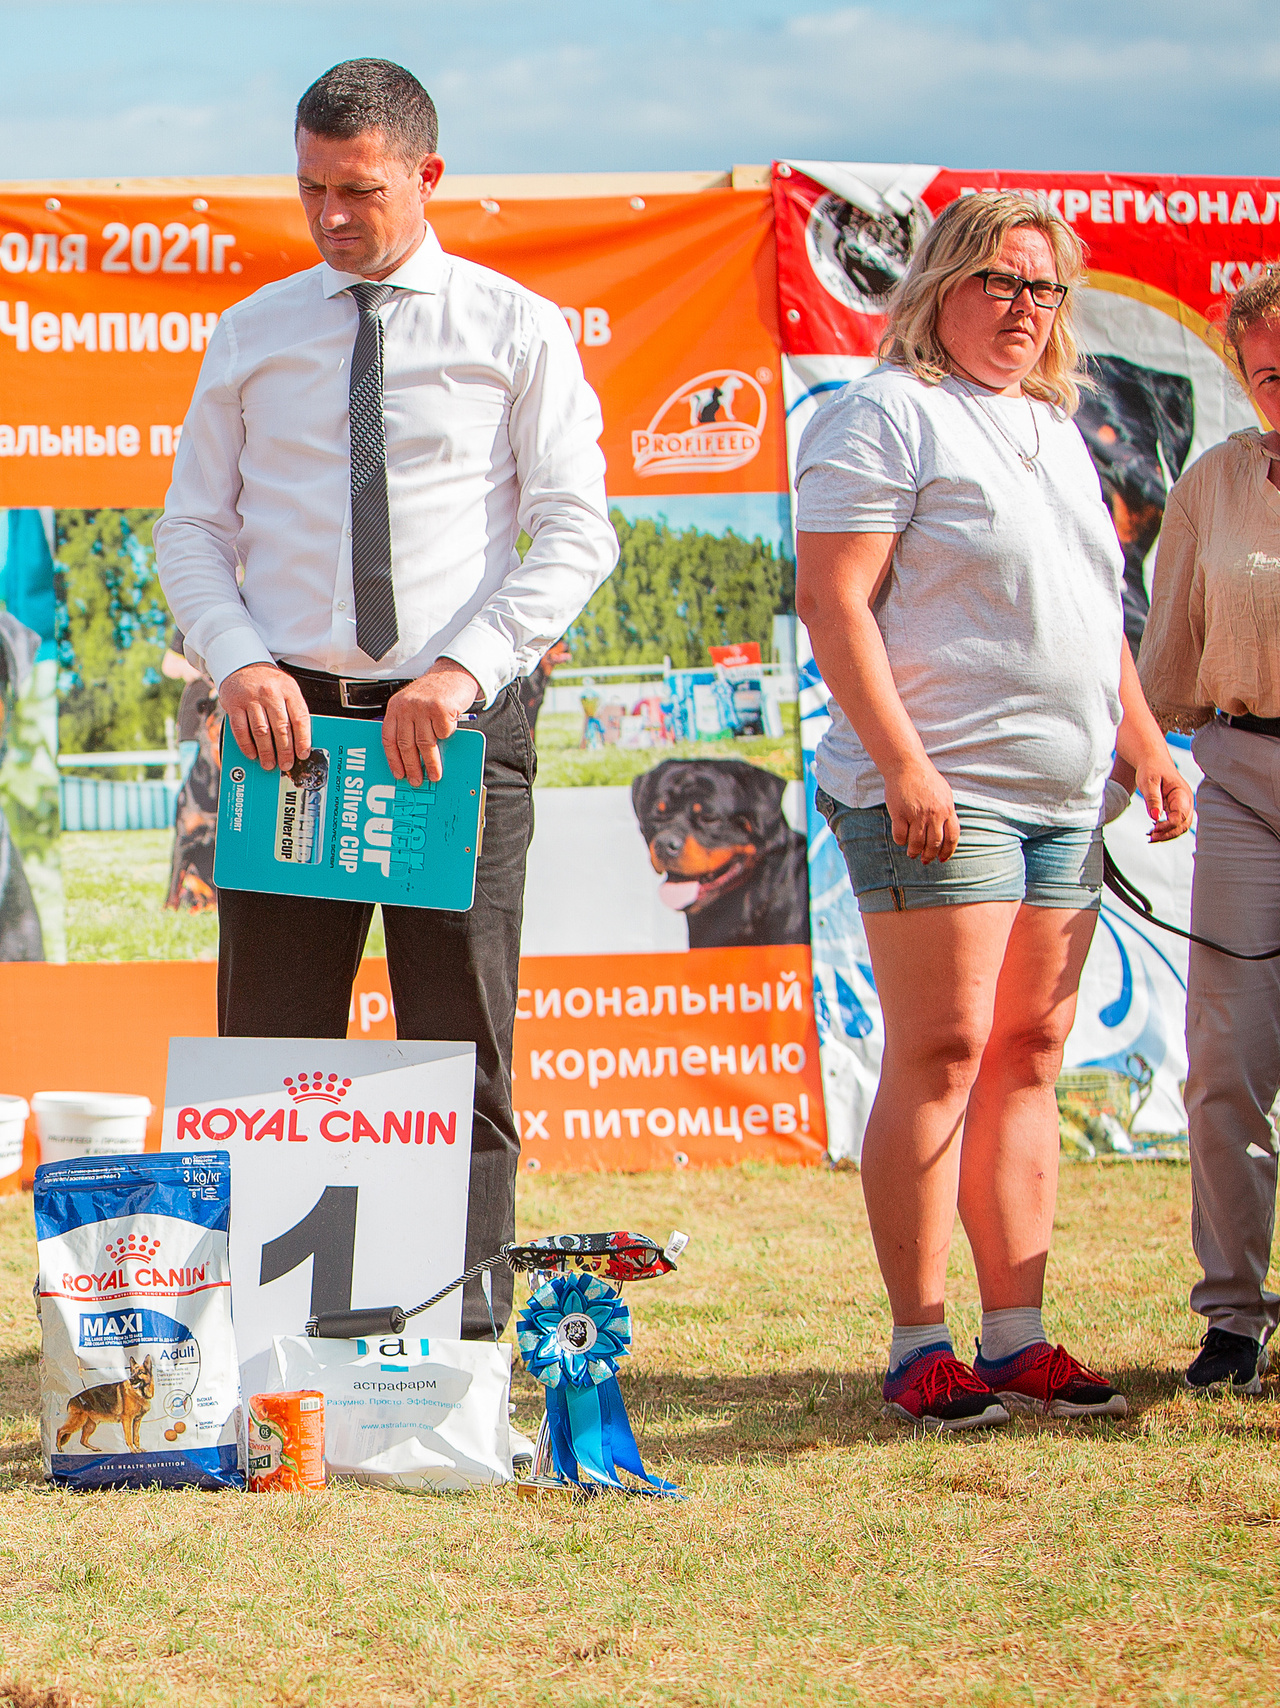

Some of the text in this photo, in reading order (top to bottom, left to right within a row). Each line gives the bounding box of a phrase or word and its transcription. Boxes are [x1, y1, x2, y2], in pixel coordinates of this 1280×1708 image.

[101, 222, 244, 275] 2021г.
[233, 783, 245, 833] TABOOSPORT
[339, 747, 366, 874] VII Silver CUP
[280, 791, 297, 860] VII Silver CUP
[530, 1042, 806, 1089] кормлению
[177, 1107, 457, 1145] ROYAL CANIN
[563, 1094, 811, 1143] питомцев!
[183, 1170, 191, 1183] 3
[259, 1185, 360, 1316] 1
[62, 1264, 206, 1293] ROYAL CANIN
[83, 1313, 143, 1337] MAXI
[160, 1345, 195, 1361] Adult
[353, 1380, 437, 1392] астрафарм
[369, 1397, 404, 1406] Просто.
[360, 1421, 434, 1432] www.astrafarm.com
[147, 1461, 185, 1469] NUTRITION
